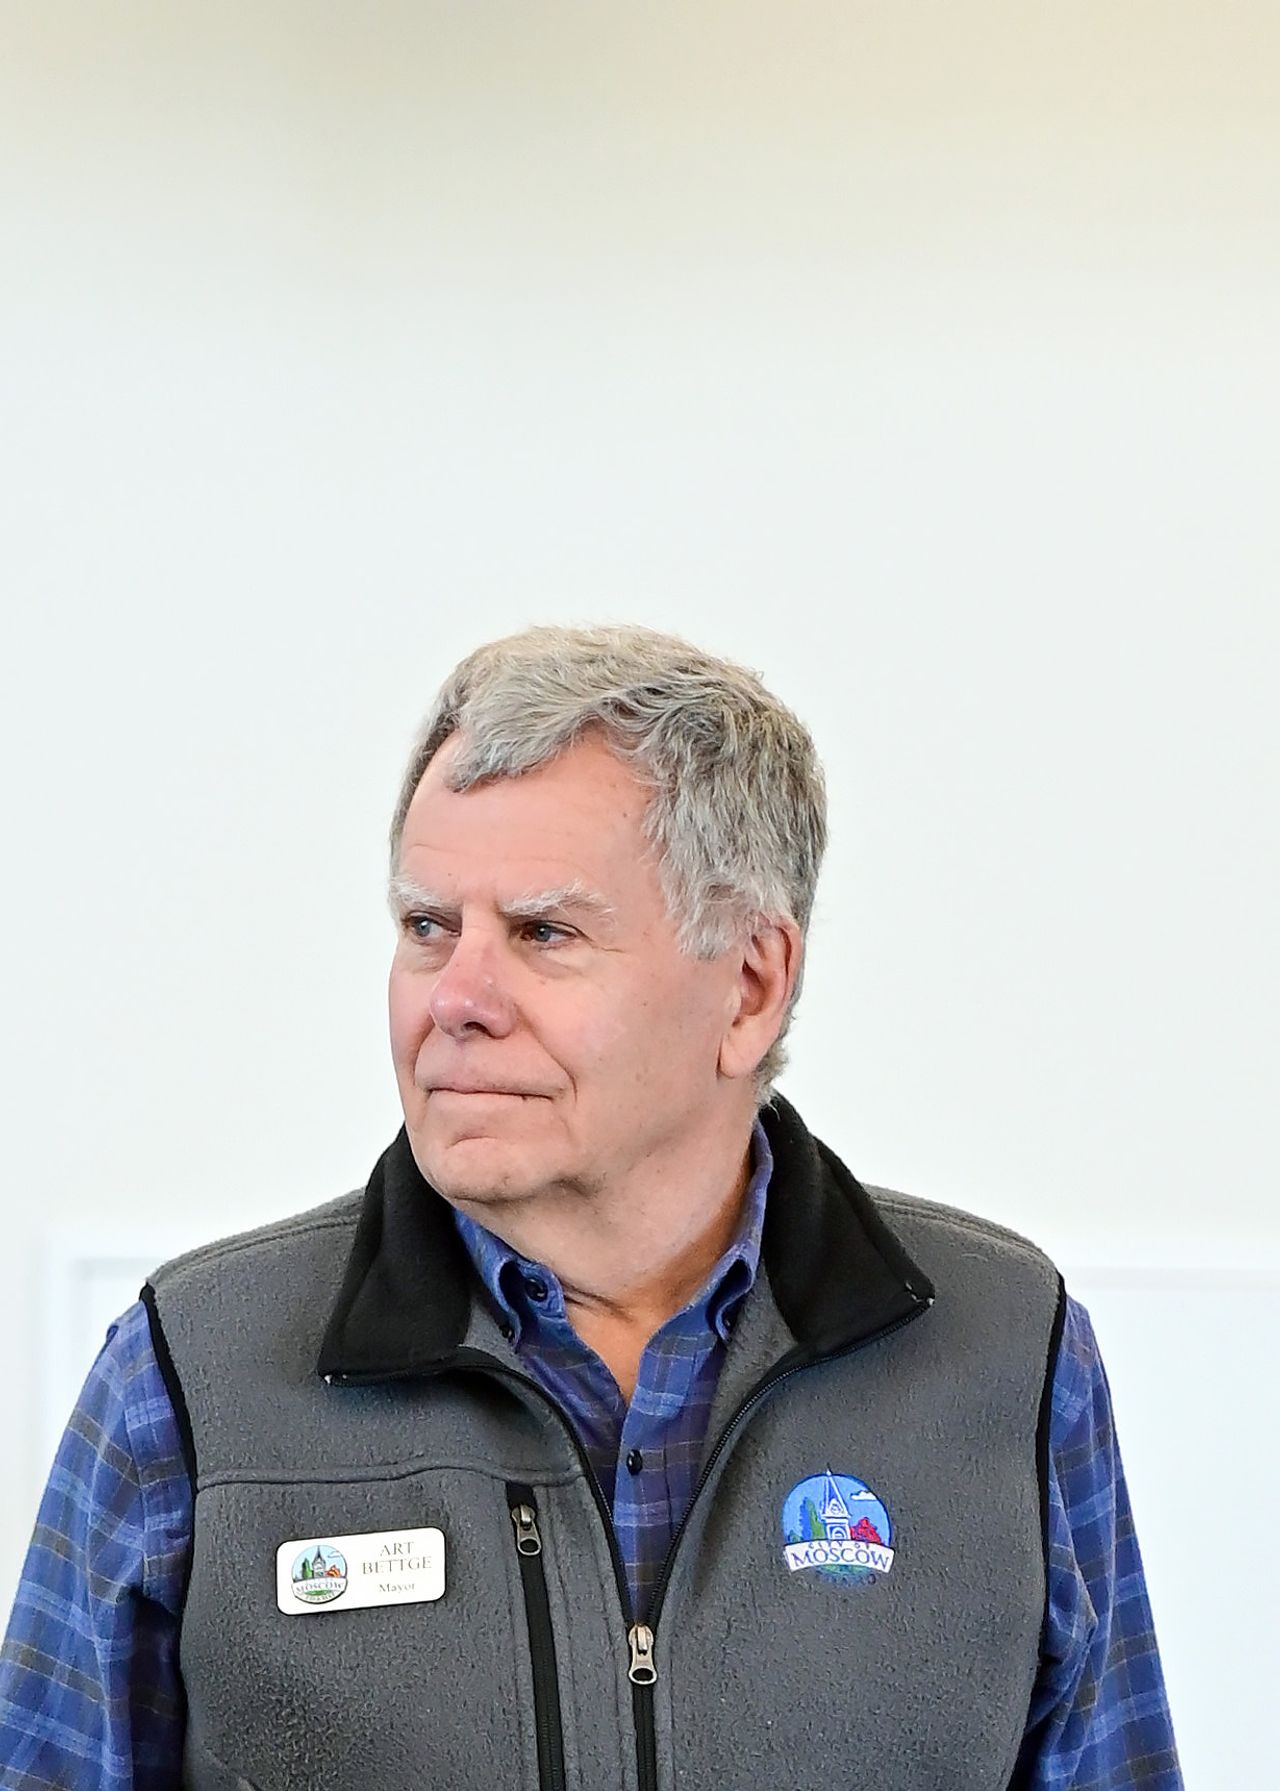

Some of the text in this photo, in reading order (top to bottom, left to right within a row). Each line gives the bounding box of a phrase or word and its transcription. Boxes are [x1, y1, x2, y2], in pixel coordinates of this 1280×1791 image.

[379, 1541, 415, 1557] ART
[362, 1556, 433, 1575] BETTGE
[791, 1547, 890, 1570] MOSCOW
[379, 1583, 416, 1594] Mayor
